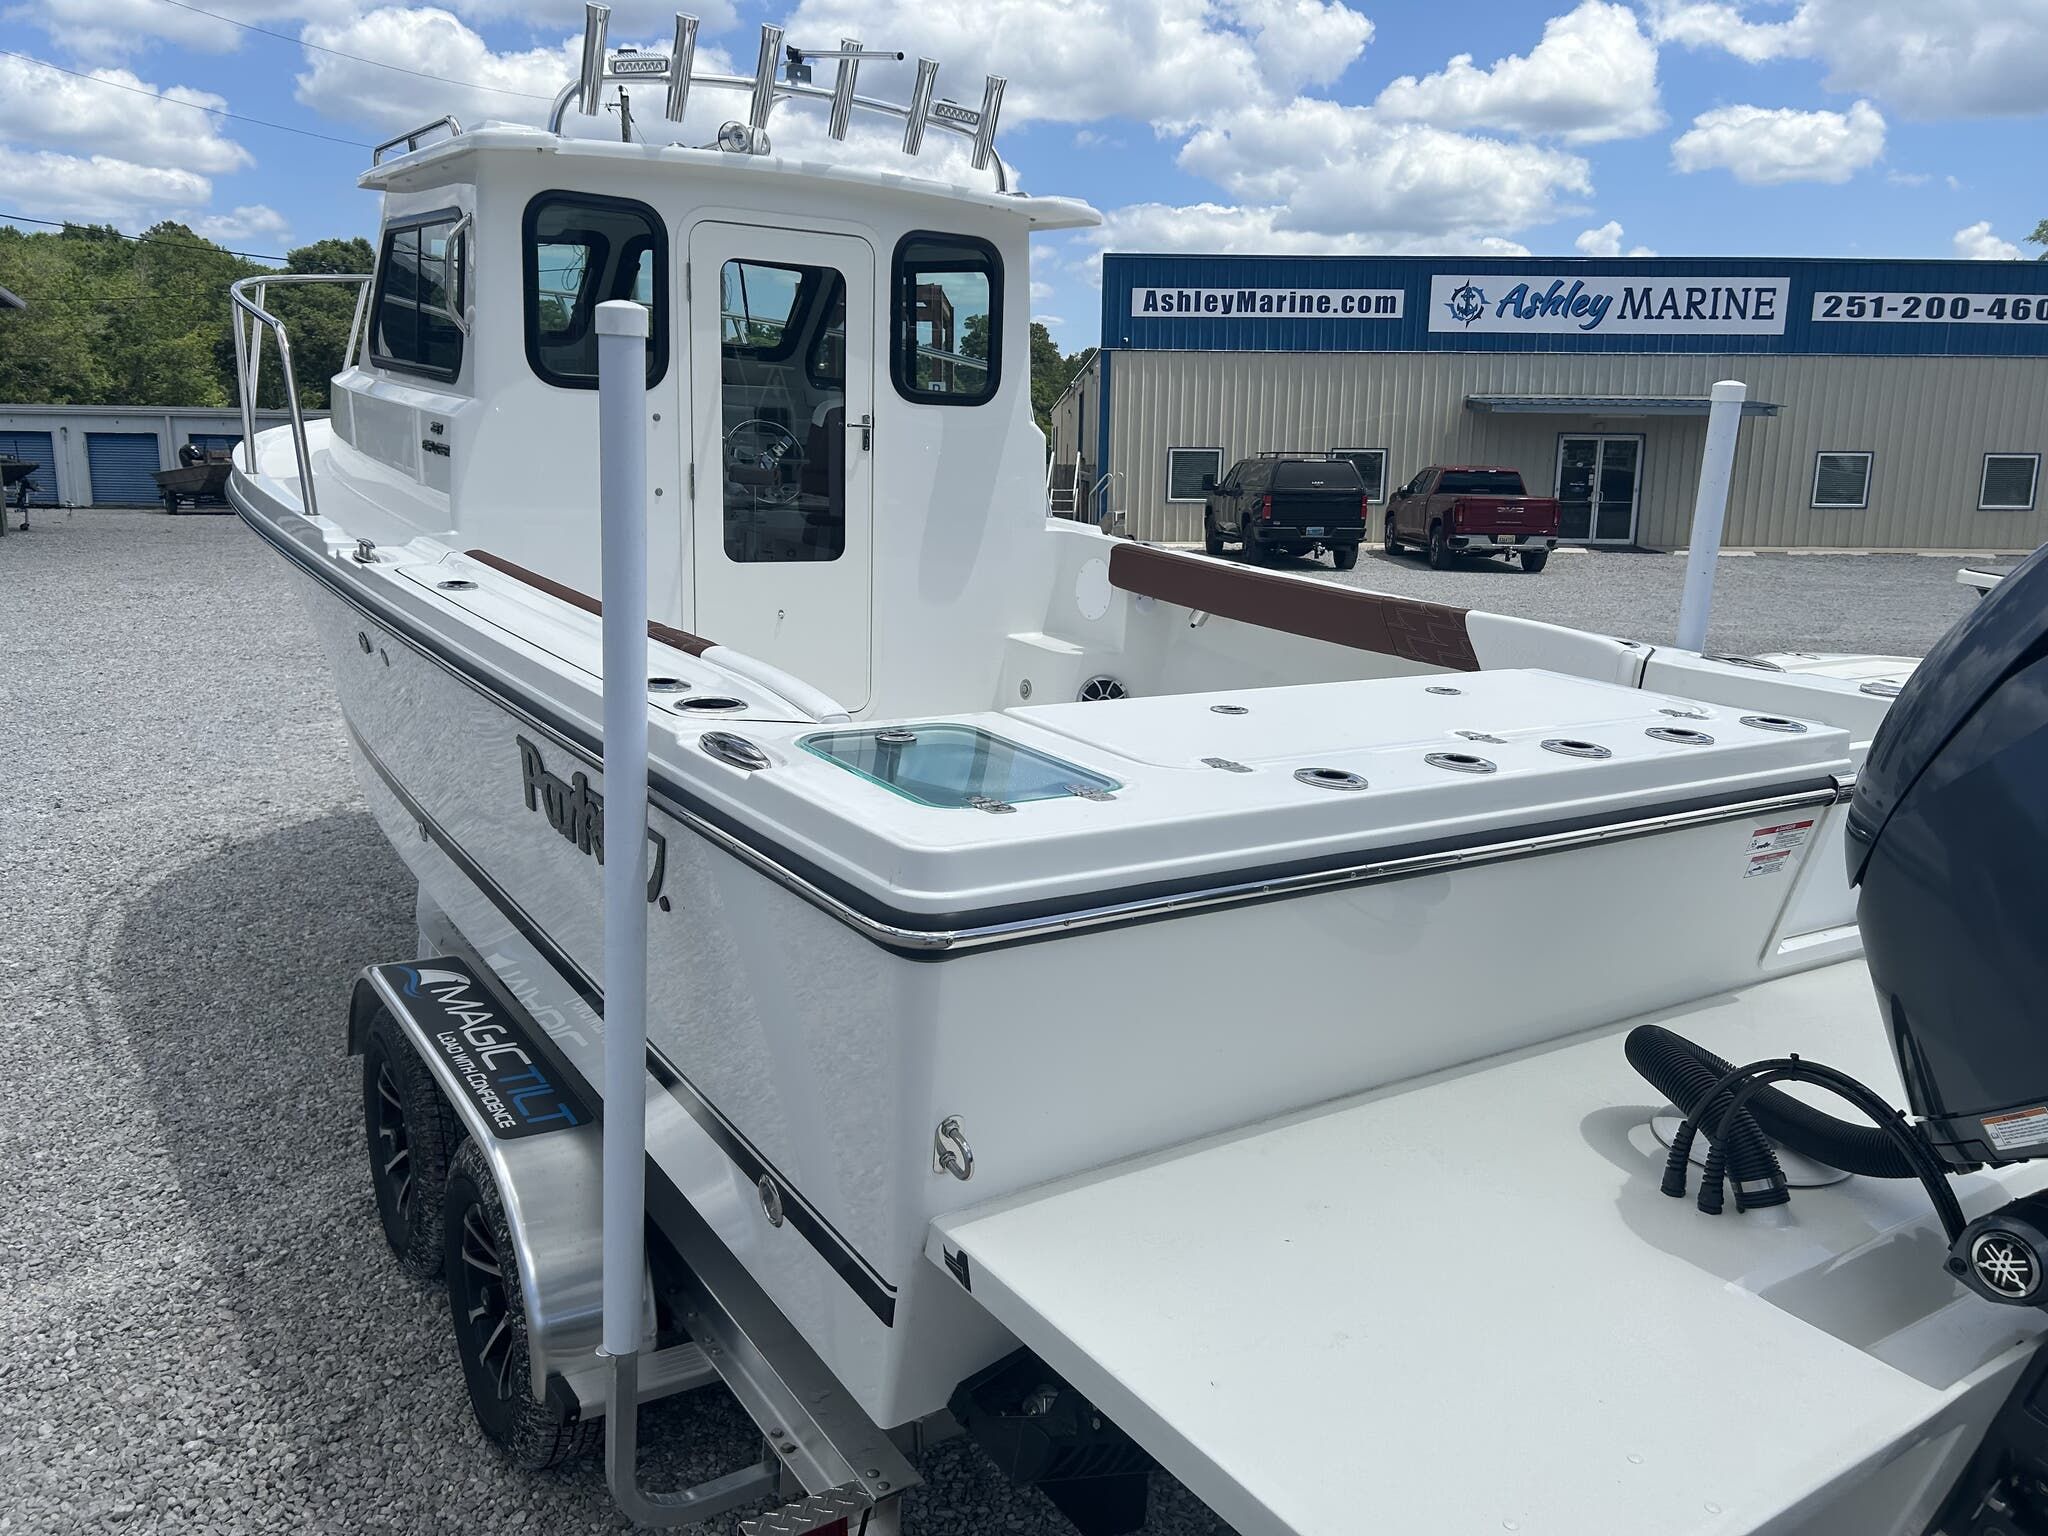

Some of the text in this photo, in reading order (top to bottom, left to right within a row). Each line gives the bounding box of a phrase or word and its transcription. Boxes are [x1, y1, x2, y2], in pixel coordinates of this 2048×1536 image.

[1142, 289, 1398, 315] AshleyMarine.com
[1495, 279, 1778, 331] Ashley MARINE
[436, 1031, 517, 1129] LOAD WITH CONFIDENCE
